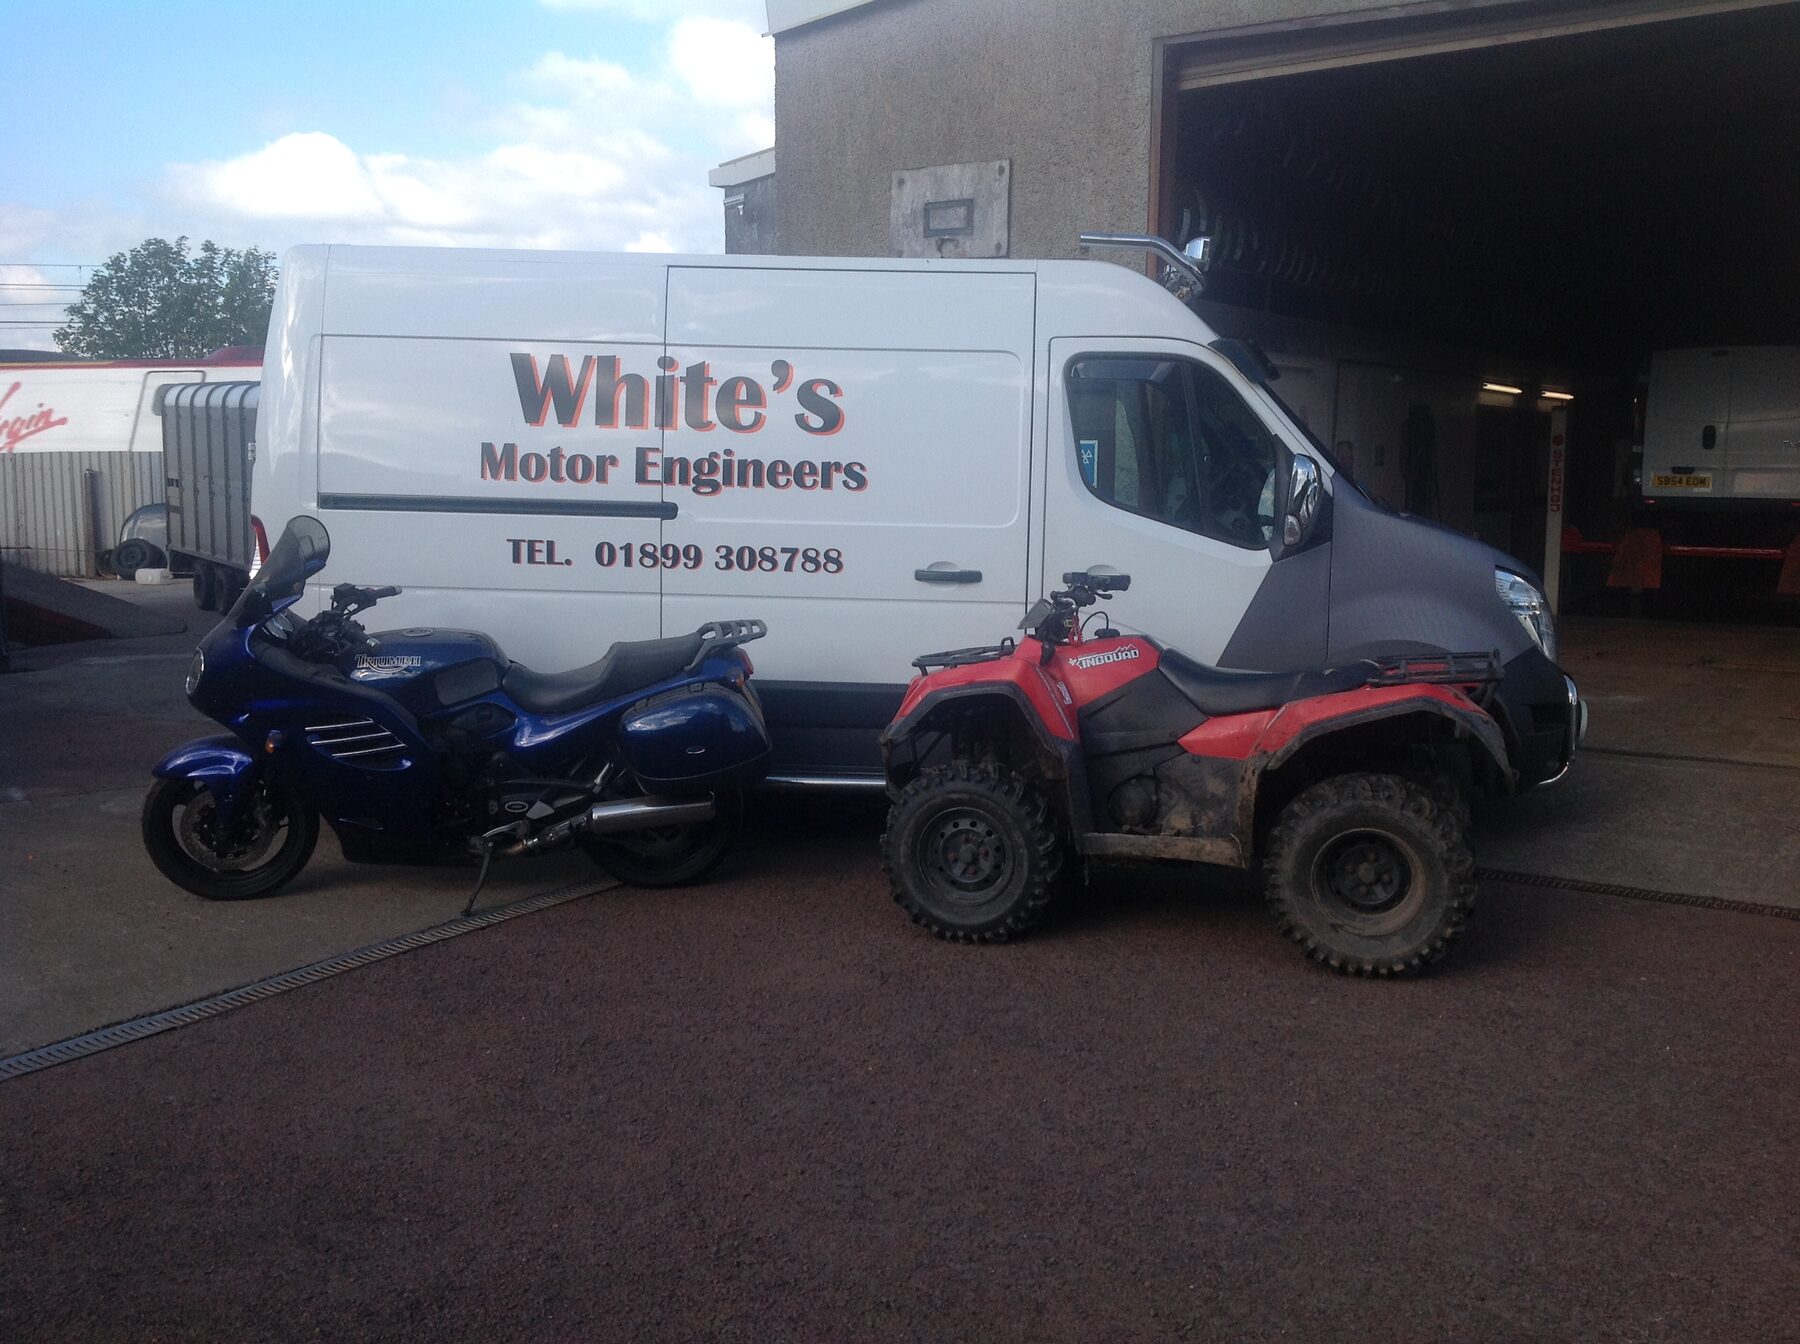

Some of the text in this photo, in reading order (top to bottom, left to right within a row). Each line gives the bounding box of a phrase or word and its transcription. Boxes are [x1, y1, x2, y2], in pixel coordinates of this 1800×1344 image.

[510, 352, 845, 436] White’s
[480, 442, 868, 496] Motor Engineers
[507, 538, 844, 573] TEL. 01899 308788
[355, 654, 421, 673] TRIUMPH
